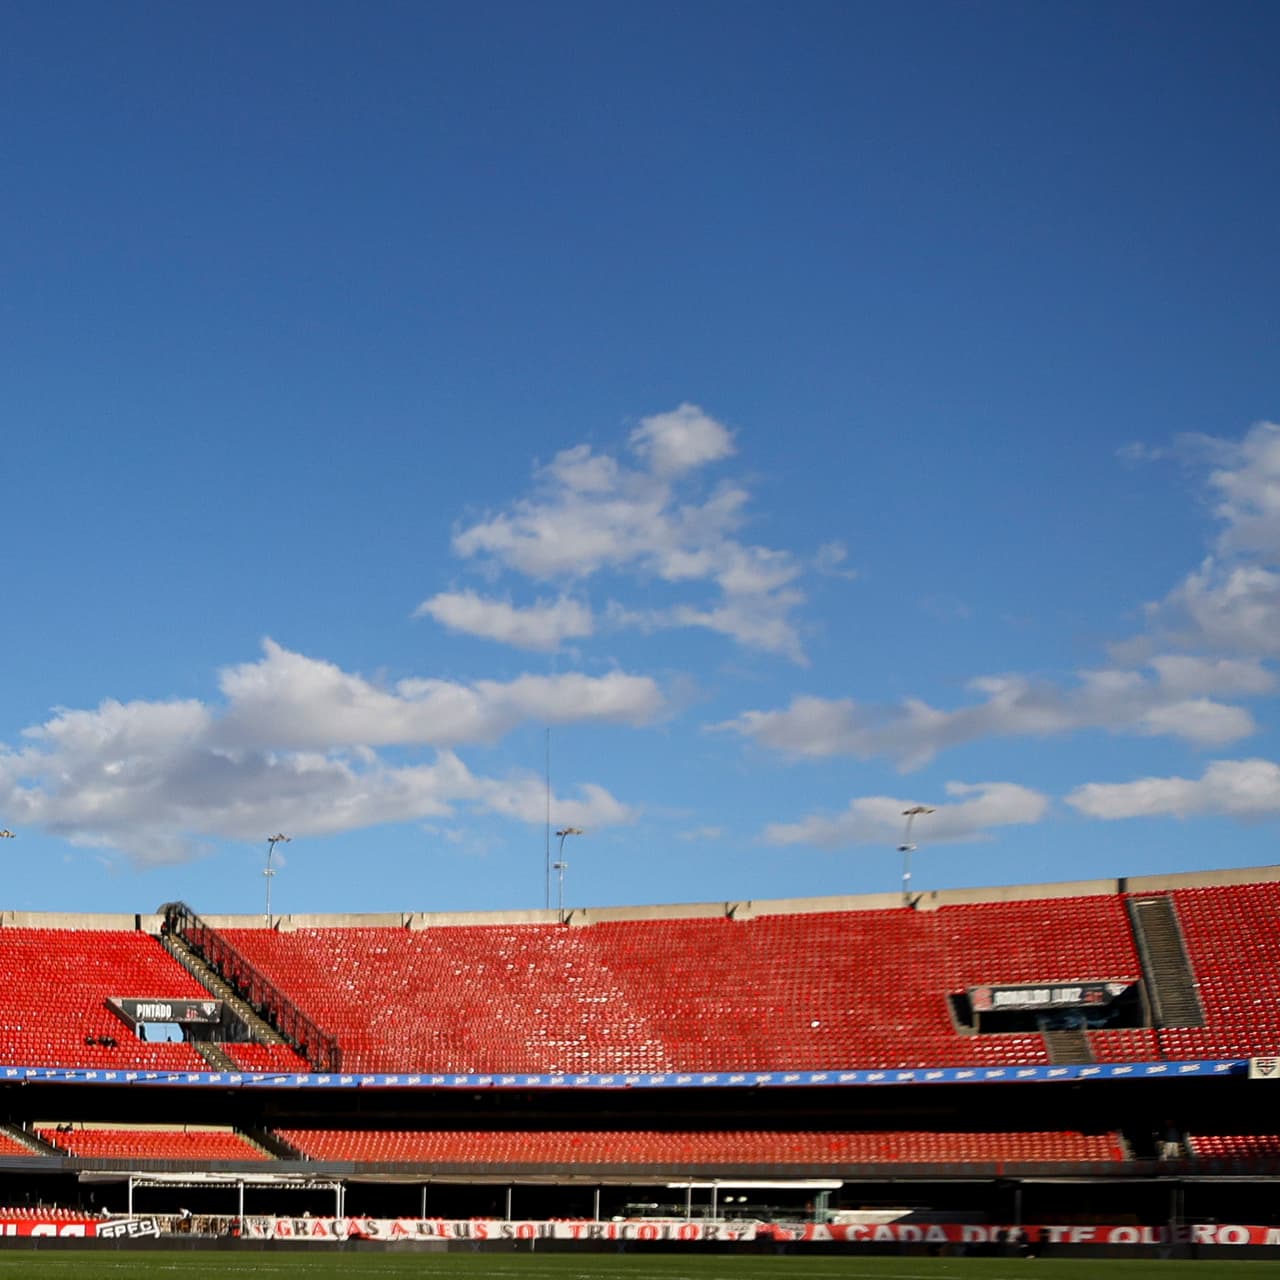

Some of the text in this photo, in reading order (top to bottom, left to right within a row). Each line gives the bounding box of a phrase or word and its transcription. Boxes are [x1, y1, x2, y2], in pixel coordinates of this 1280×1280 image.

[136, 1003, 172, 1018] PINTADO
[275, 1221, 379, 1239] GRAÇAS
[391, 1222, 410, 1236] A
[502, 1224, 556, 1239] SOU
[568, 1223, 720, 1240] TRICOLOR
[812, 1225, 834, 1241] A
[846, 1225, 949, 1242] CADA
